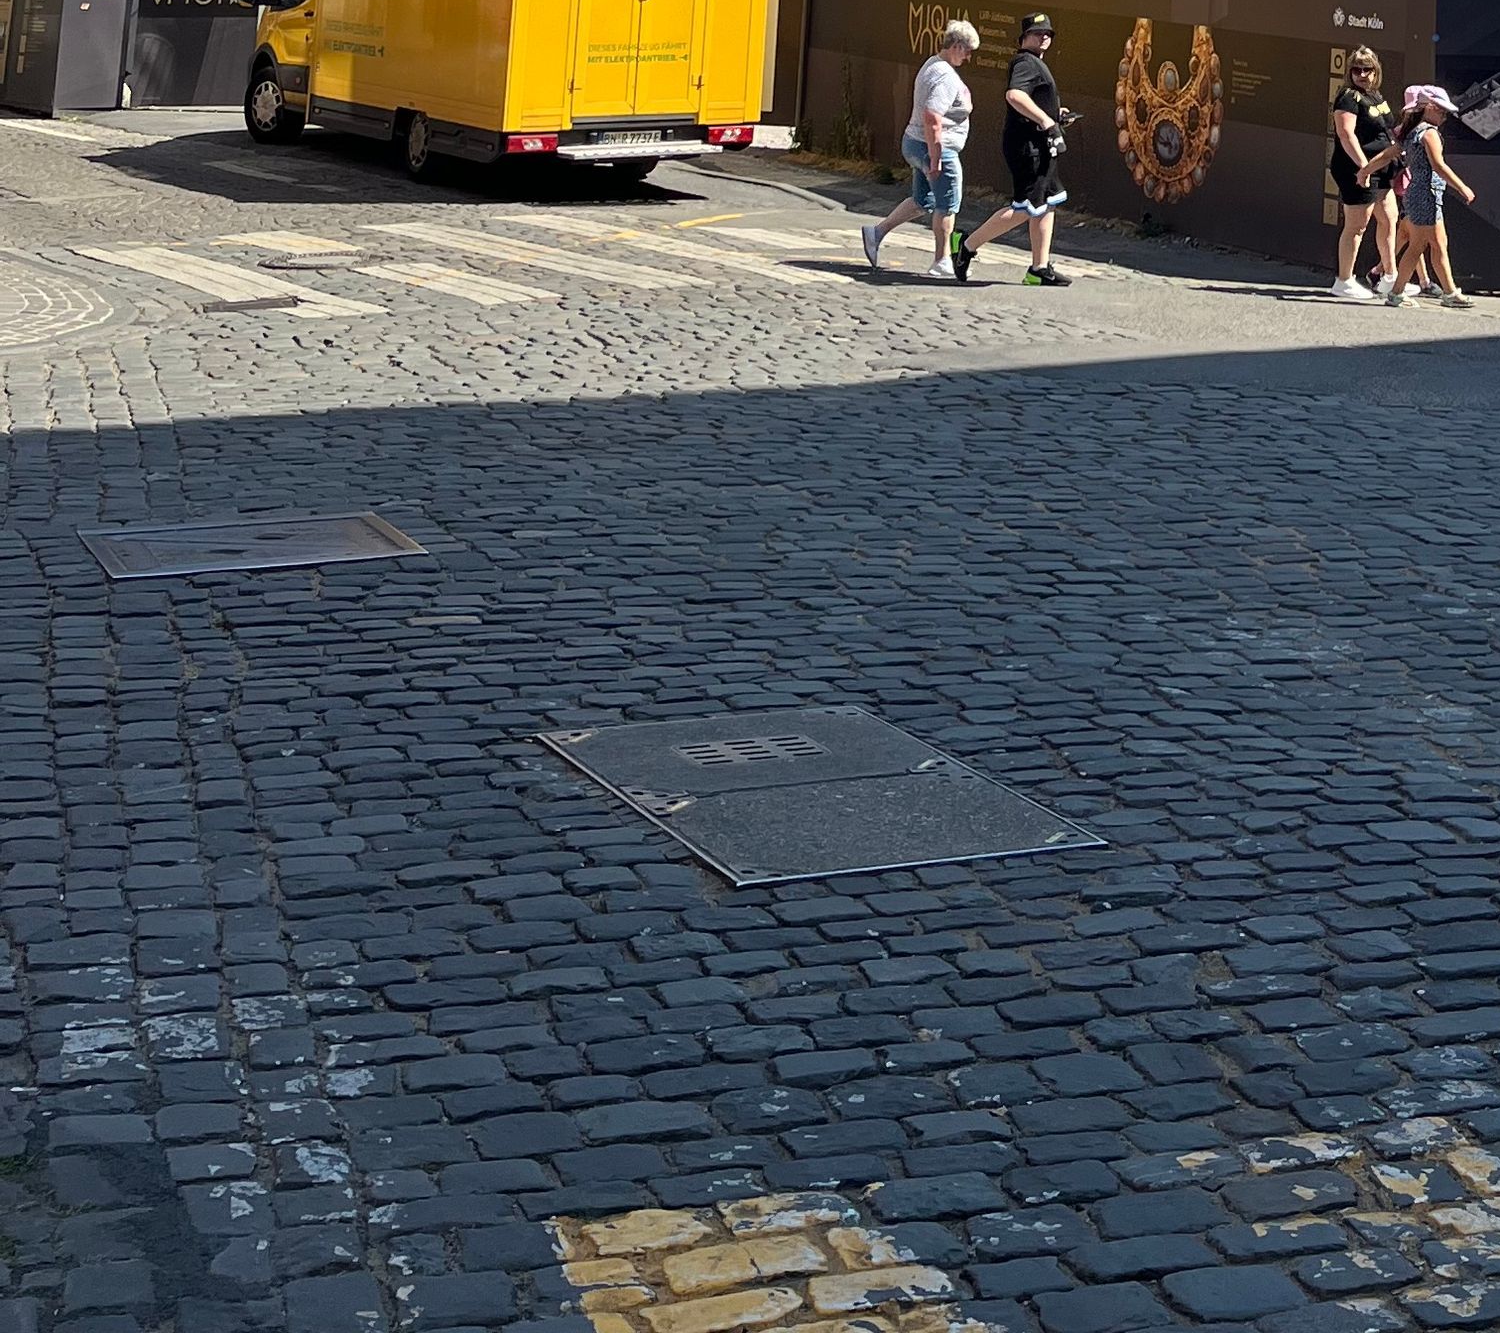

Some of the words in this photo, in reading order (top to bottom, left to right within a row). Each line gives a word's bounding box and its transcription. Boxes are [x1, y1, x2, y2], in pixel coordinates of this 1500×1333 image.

[1347, 13, 1368, 29] Stadt
[1368, 13, 1384, 30] Köln
[587, 43, 617, 53] DIESES
[587, 54, 603, 64] MIT
